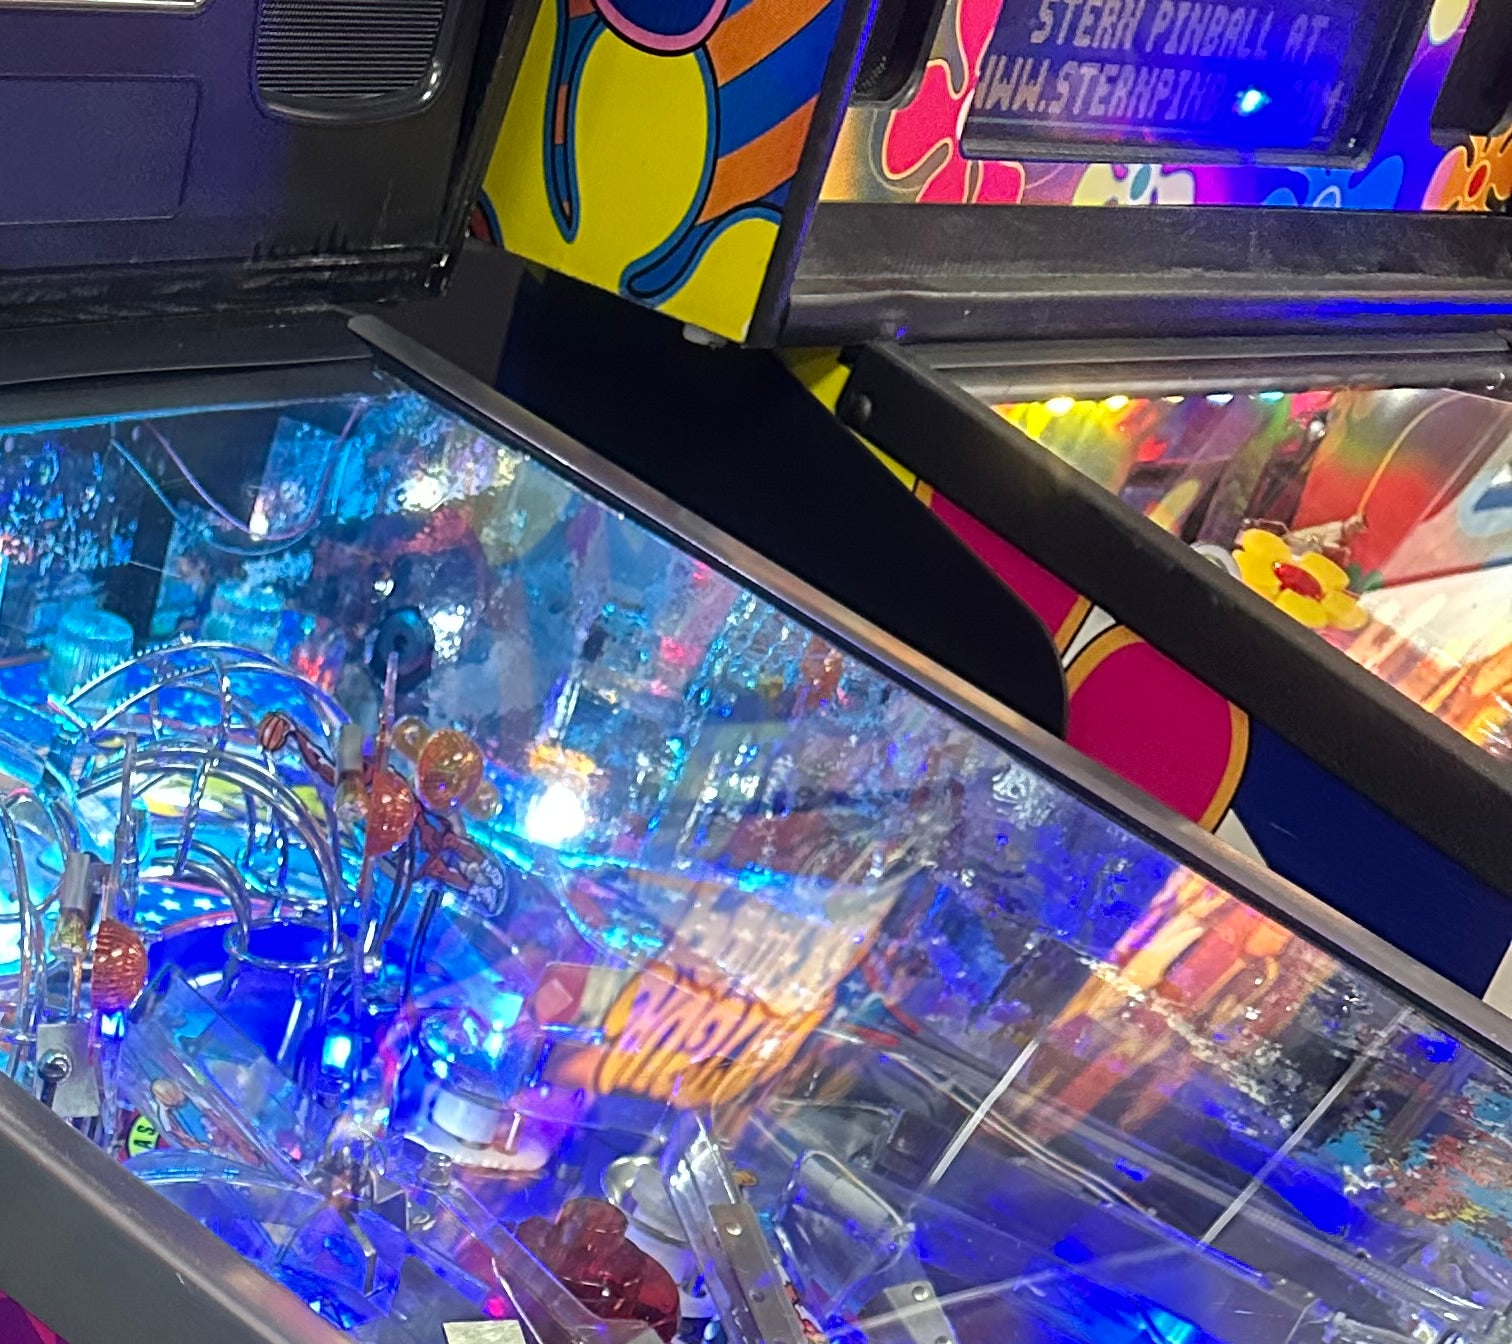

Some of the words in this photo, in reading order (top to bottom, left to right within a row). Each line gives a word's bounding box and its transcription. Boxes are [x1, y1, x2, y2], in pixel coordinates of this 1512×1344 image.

[1030, 0, 1145, 49] STERN
[1144, 1, 1275, 58] PINBALL
[1282, 13, 1331, 64] AT
